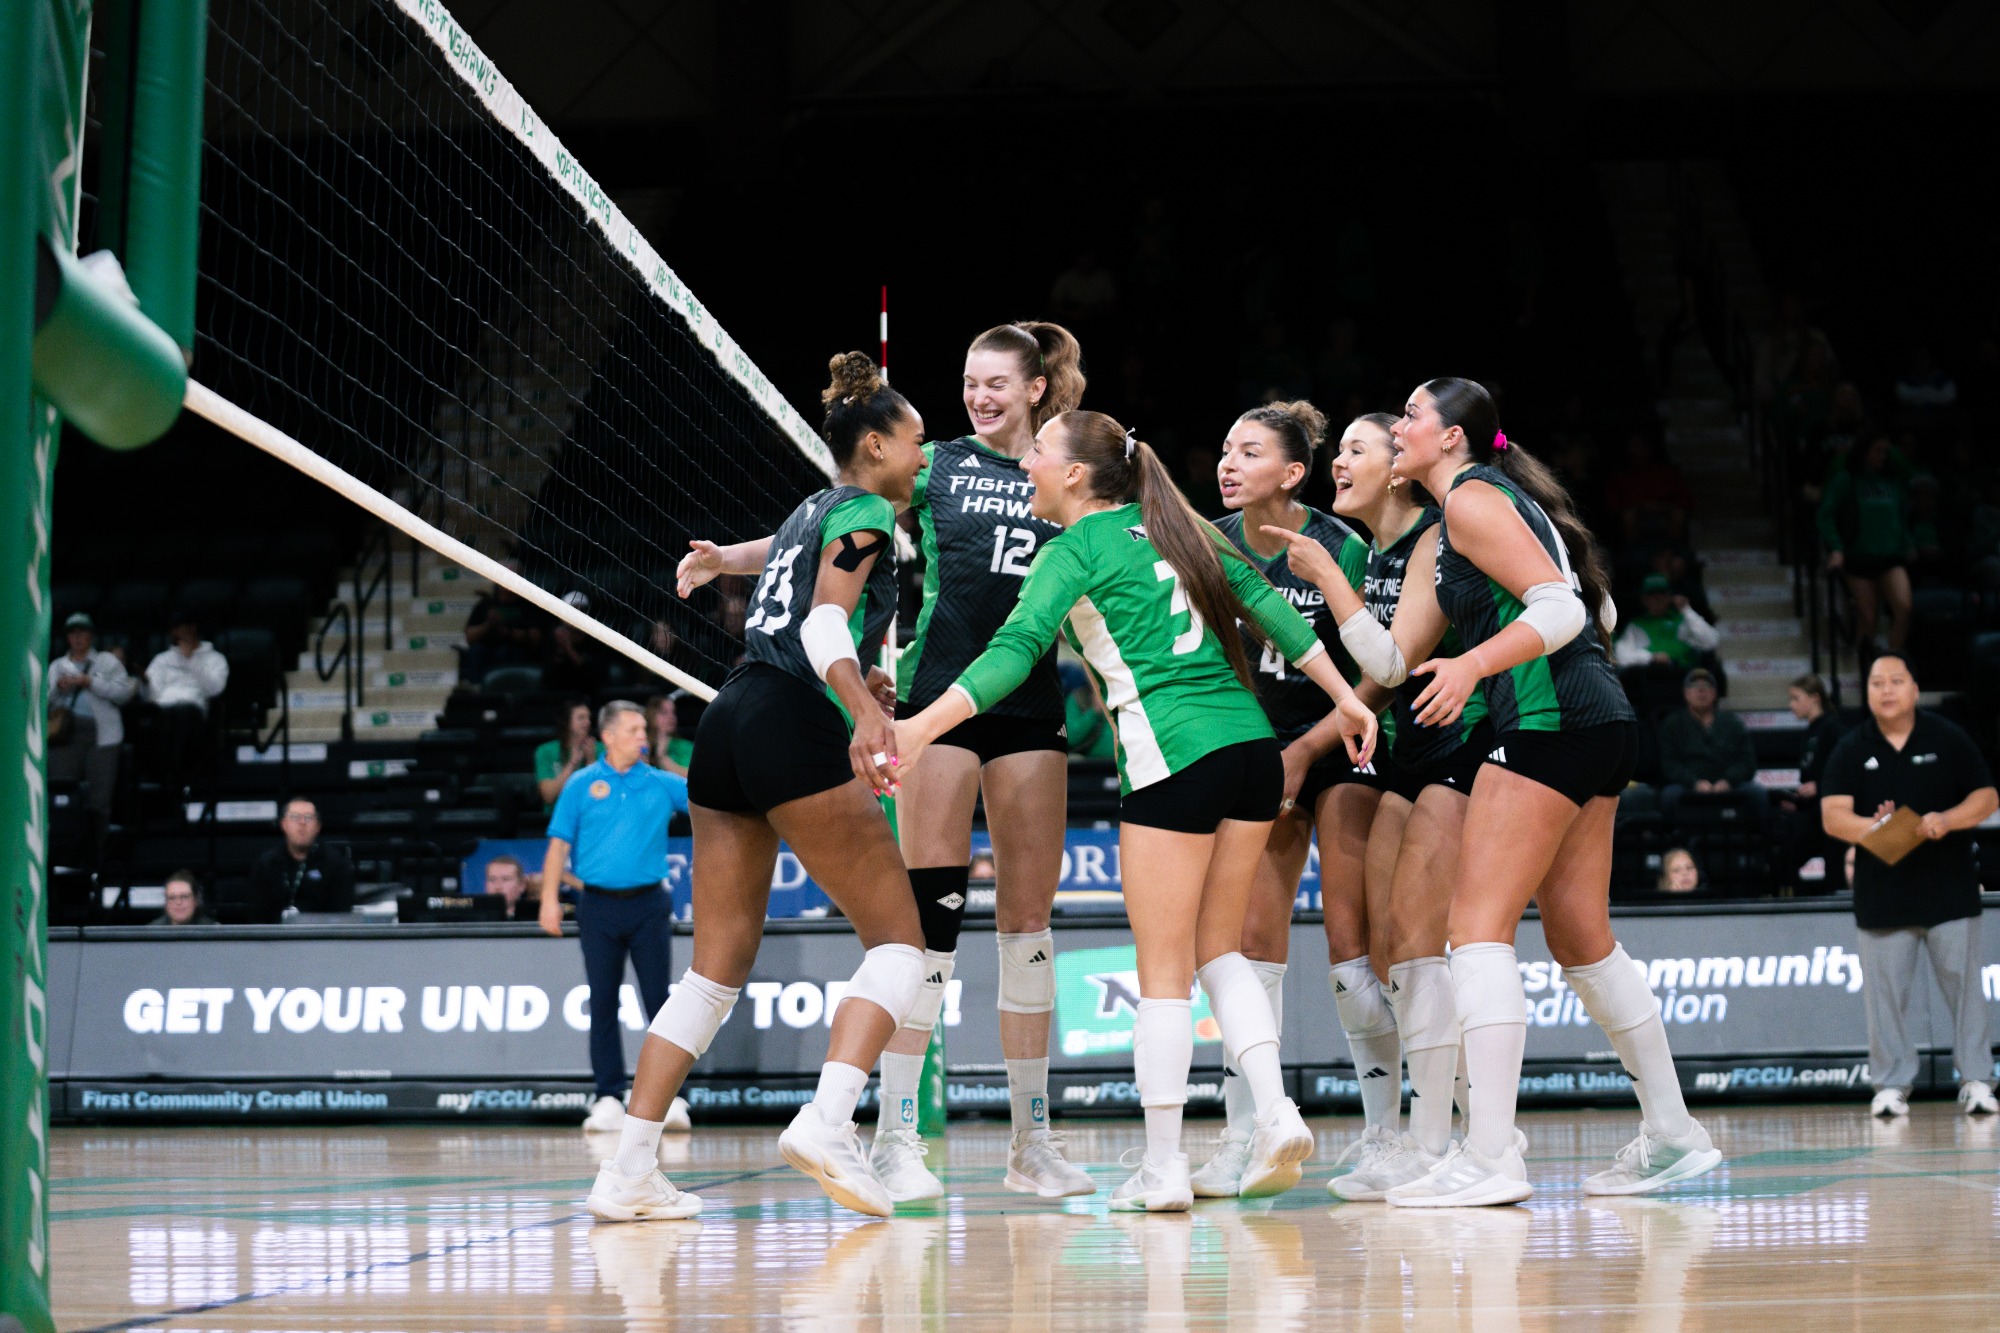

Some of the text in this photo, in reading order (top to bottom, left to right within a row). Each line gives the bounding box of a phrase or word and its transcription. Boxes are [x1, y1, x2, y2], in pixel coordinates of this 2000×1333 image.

[948, 475, 1035, 496] FIGHT
[961, 495, 1063, 529] HAW
[990, 525, 1037, 577] 12
[123, 987, 234, 1034] GET
[244, 986, 407, 1034] YOUR
[420, 984, 550, 1033] UND
[82, 1091, 131, 1109] First
[133, 1090, 253, 1112] Community
[255, 1090, 323, 1108] Credit
[325, 1089, 389, 1108] Union
[436, 1089, 597, 1113] myFCCU.com/
[688, 1086, 741, 1107] First
[947, 1084, 1011, 1104] Union
[1316, 1076, 1360, 1096] Firs
[1520, 1073, 1576, 1091] redit
[1578, 1071, 1632, 1090] Unio
